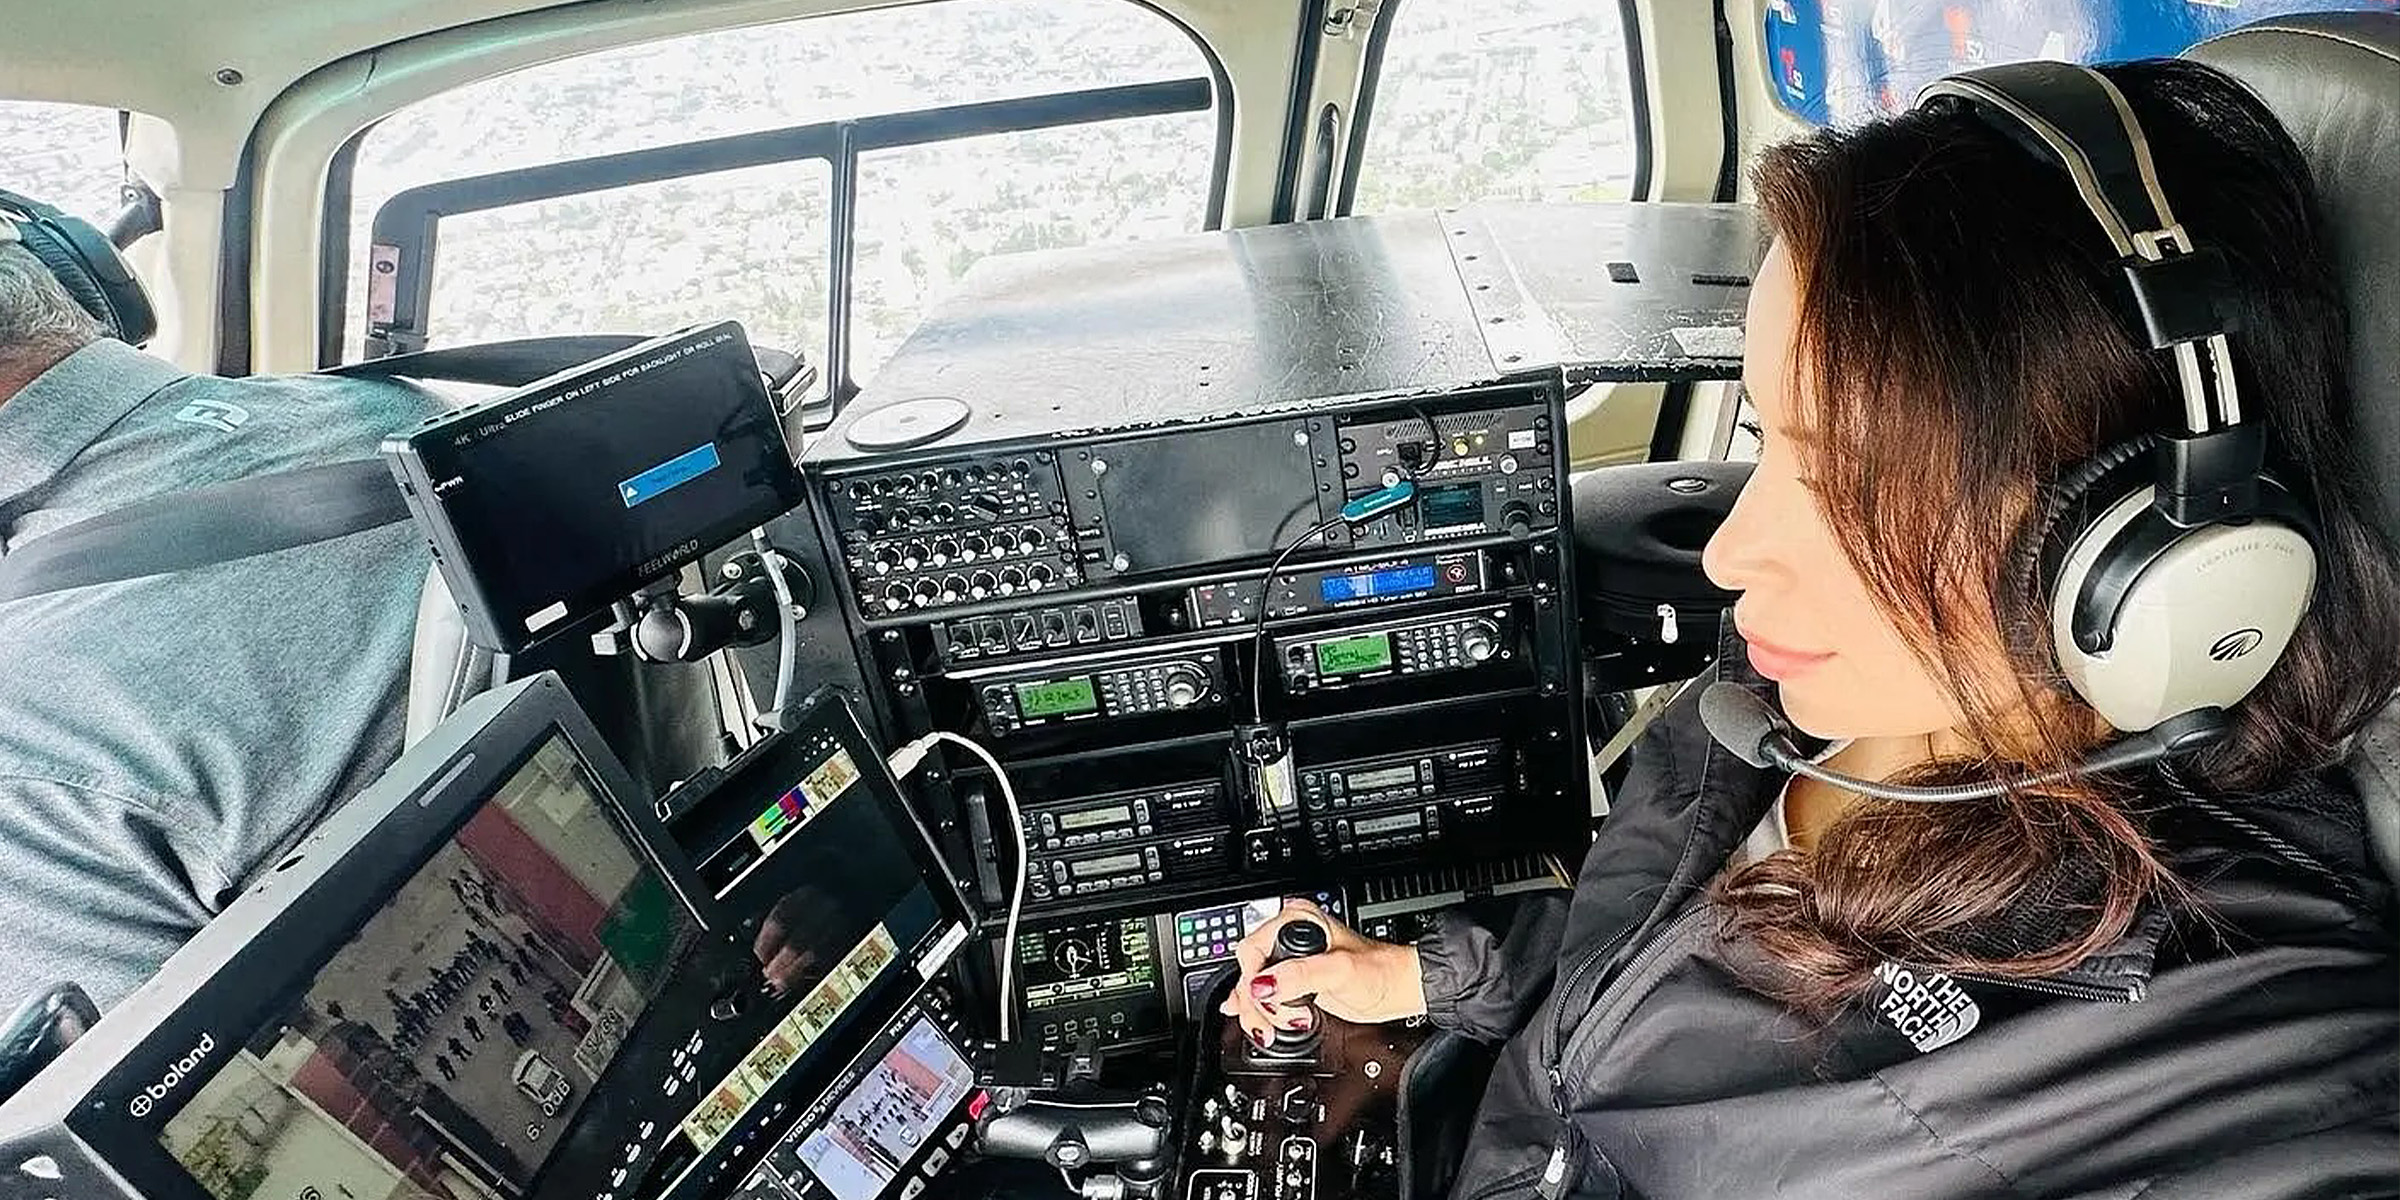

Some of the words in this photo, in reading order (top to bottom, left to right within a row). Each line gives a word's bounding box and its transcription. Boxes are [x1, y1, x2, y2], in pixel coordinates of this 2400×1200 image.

[504, 408, 531, 423] SLIDE
[531, 396, 564, 414] FINGER
[565, 391, 579, 401] ON
[580, 381, 601, 395] LEFT
[602, 374, 621, 387] SIDE
[622, 367, 640, 379] FOR
[641, 351, 682, 372] BACKLIGHT
[454, 434, 472, 447] 4K
[638, 539, 698, 577] FEELWORLD
[1873, 960, 1954, 1030] NORTH
[1880, 990, 1934, 1044] FACE
[1925, 973, 1973, 1014] THE
[145, 1032, 215, 1100] boland
[785, 1113, 816, 1143] VIDEO
[821, 1070, 855, 1106] DEVICES
